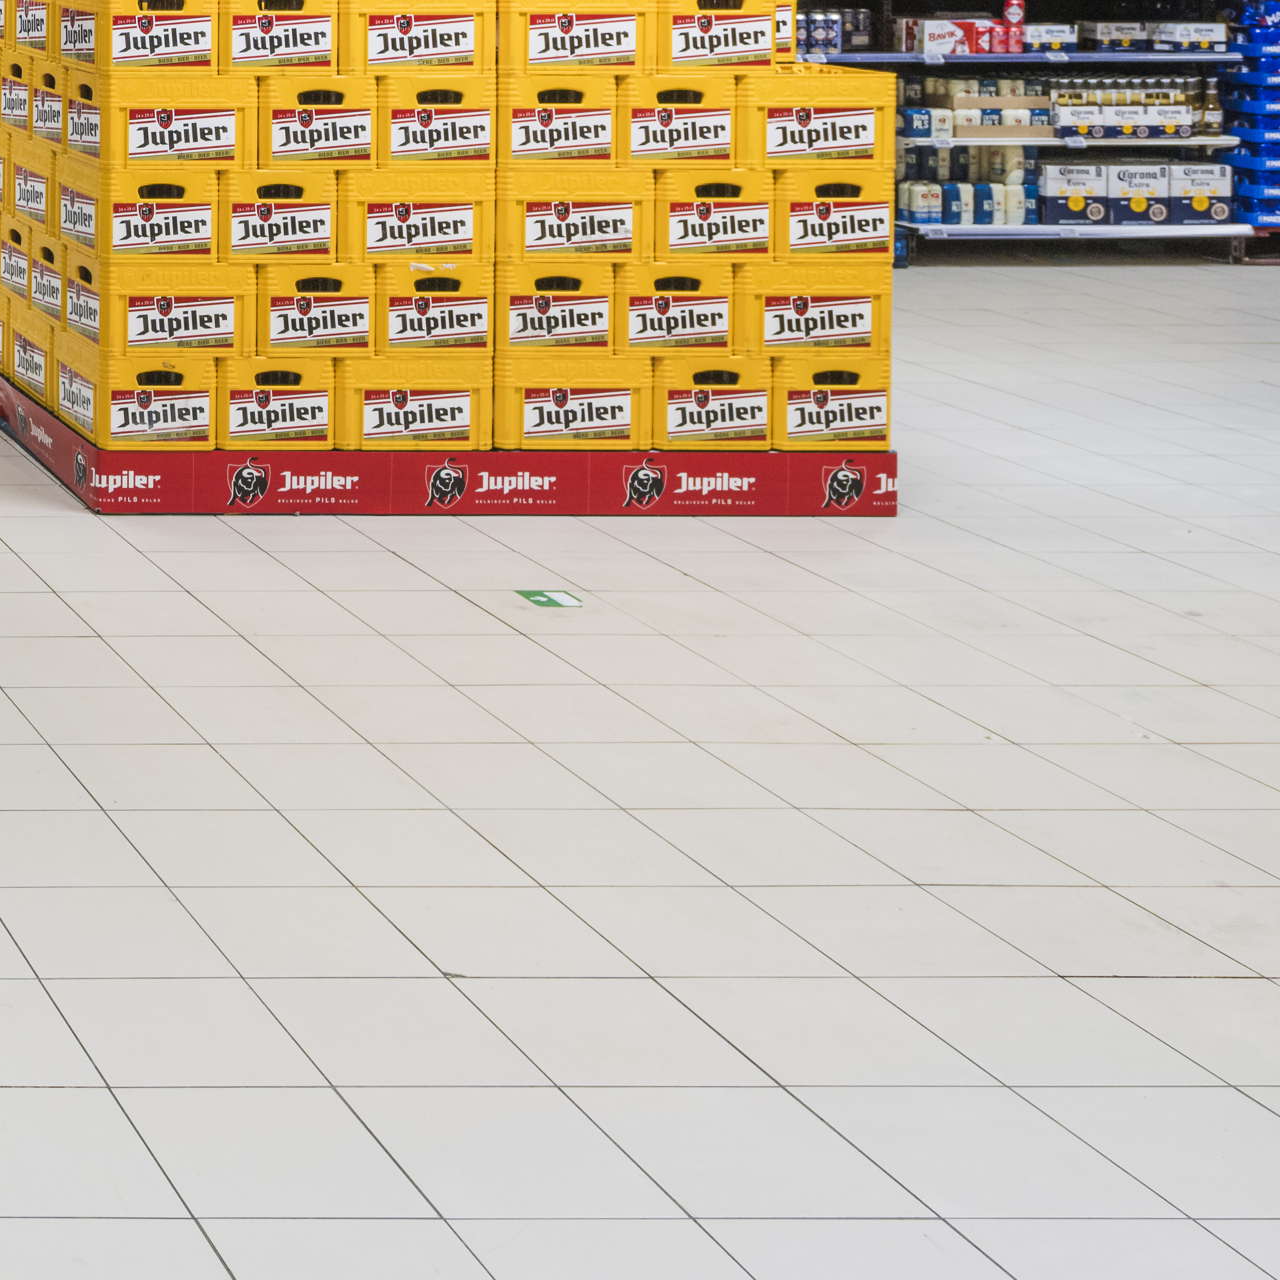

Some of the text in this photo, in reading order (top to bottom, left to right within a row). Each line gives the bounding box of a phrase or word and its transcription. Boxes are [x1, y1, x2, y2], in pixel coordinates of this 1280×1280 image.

[120, 27, 205, 58] Jupiler
[240, 28, 326, 59] Jupiler
[378, 28, 467, 59] Jupiler
[539, 28, 629, 59] Jupiler
[680, 27, 765, 58] Jupiler
[138, 122, 227, 153] Jupiler
[280, 121, 366, 152] Jupiler
[399, 121, 485, 152] Jupiler
[520, 121, 605, 152] Jupiler
[640, 121, 726, 152] Jupiler
[776, 122, 866, 153] Jupiler
[120, 215, 206, 246] Jupiler
[239, 215, 325, 246] Jupiler
[376, 216, 466, 247] Jupiler
[535, 215, 625, 246] Jupiler
[679, 215, 764, 246] Jupiler
[798, 214, 884, 245] Jupiler
[137, 310, 227, 341] Jupiler
[278, 309, 364, 340] Jupiler
[396, 309, 482, 340] Jupiler
[517, 308, 603, 339] Jupiler
[637, 309, 722, 340] Jupiler
[774, 309, 863, 340] Jupiler
[119, 403, 204, 434] Jupiler
[237, 402, 324, 434] Jupiler
[373, 403, 463, 434] Jupiler
[533, 402, 623, 433] Jupiler
[676, 402, 762, 433] Jupiler
[796, 402, 881, 433] Jupiler
[89, 468, 159, 494] Jupiler
[278, 470, 356, 494] Jupiler
[475, 471, 554, 494] Jupiler
[674, 472, 753, 494] Jupiler
